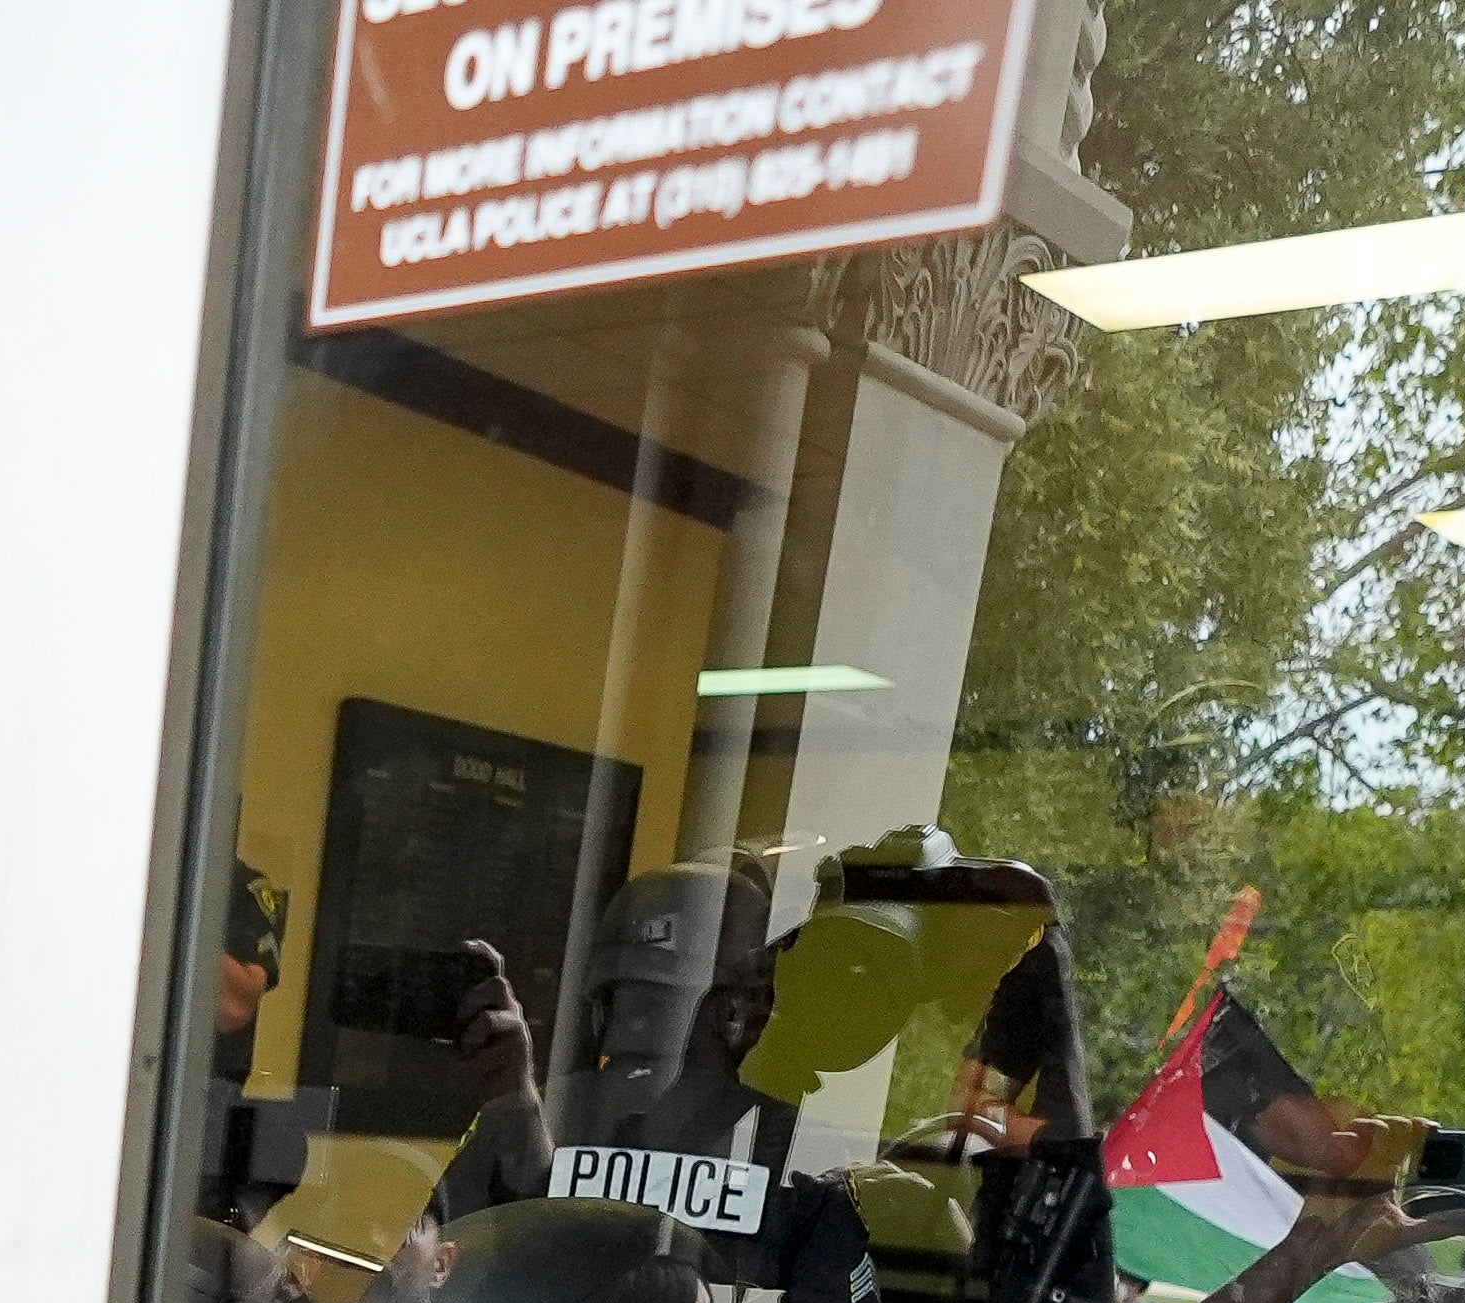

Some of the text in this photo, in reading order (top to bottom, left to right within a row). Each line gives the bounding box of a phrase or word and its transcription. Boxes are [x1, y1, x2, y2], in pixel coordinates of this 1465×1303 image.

[444, 22, 541, 111] ON
[352, 42, 986, 211] FOR MORE INFORMATION CONTACT
[380, 206, 473, 268] UCLA
[473, 180, 602, 251] POLICE
[601, 172, 659, 230] AT
[570, 1151, 746, 1223] POLICE
